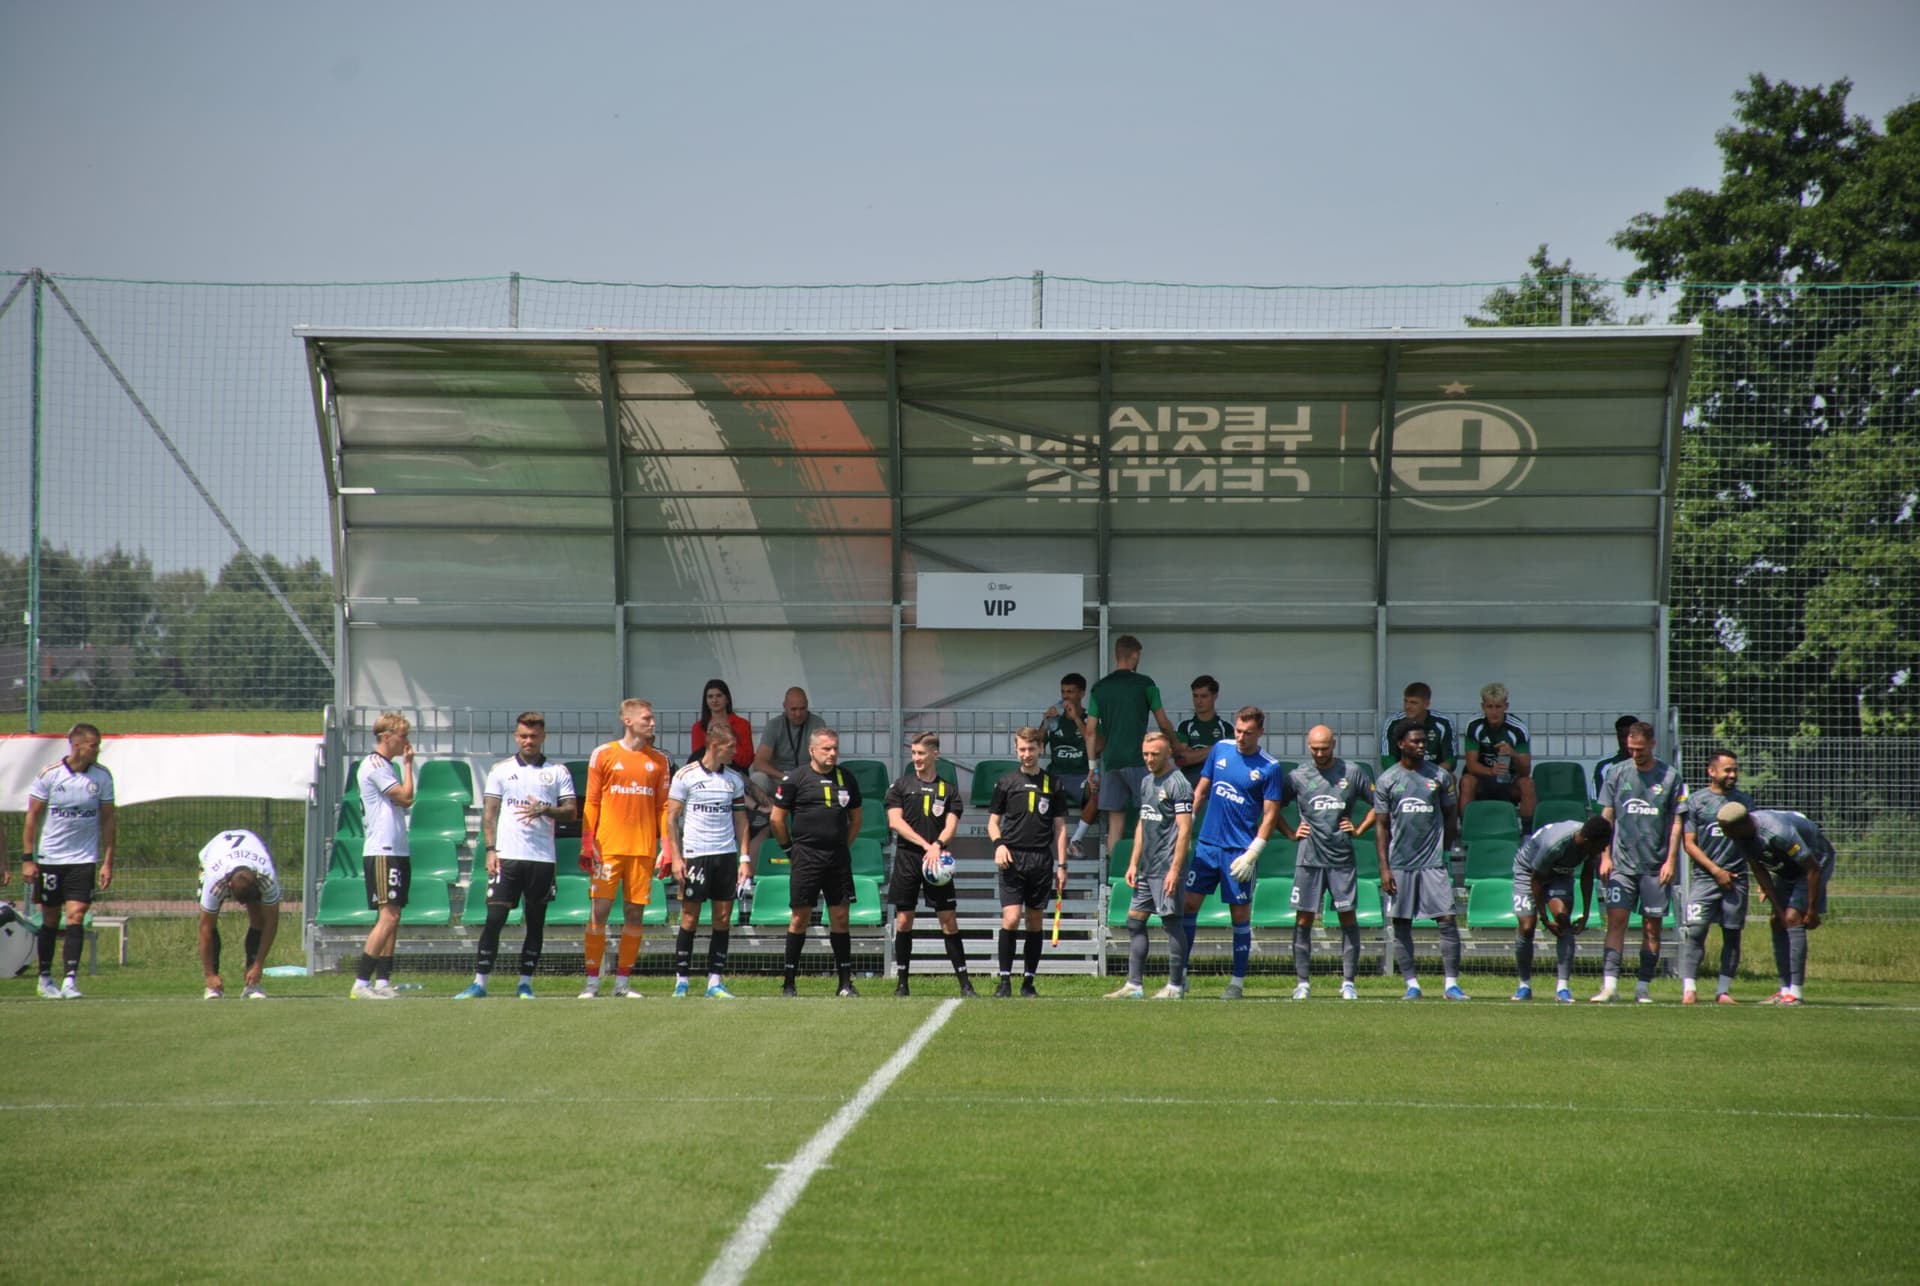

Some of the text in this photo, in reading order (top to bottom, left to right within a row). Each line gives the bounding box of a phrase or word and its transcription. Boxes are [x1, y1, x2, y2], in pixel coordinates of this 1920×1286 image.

[984, 600, 1016, 616] VIP
[1057, 749, 1083, 759] Enea
[1216, 785, 1245, 805] Enea
[1314, 801, 1346, 811] Enea
[1402, 803, 1434, 814] Enea
[1627, 803, 1659, 816] Enea
[1140, 810, 1163, 822] Enea
[226, 850, 266, 866] DEZIEL
[42, 873, 57, 890] 13
[687, 865, 705, 884] 44
[1290, 886, 1300, 903] 5
[1513, 895, 1532, 912] 24
